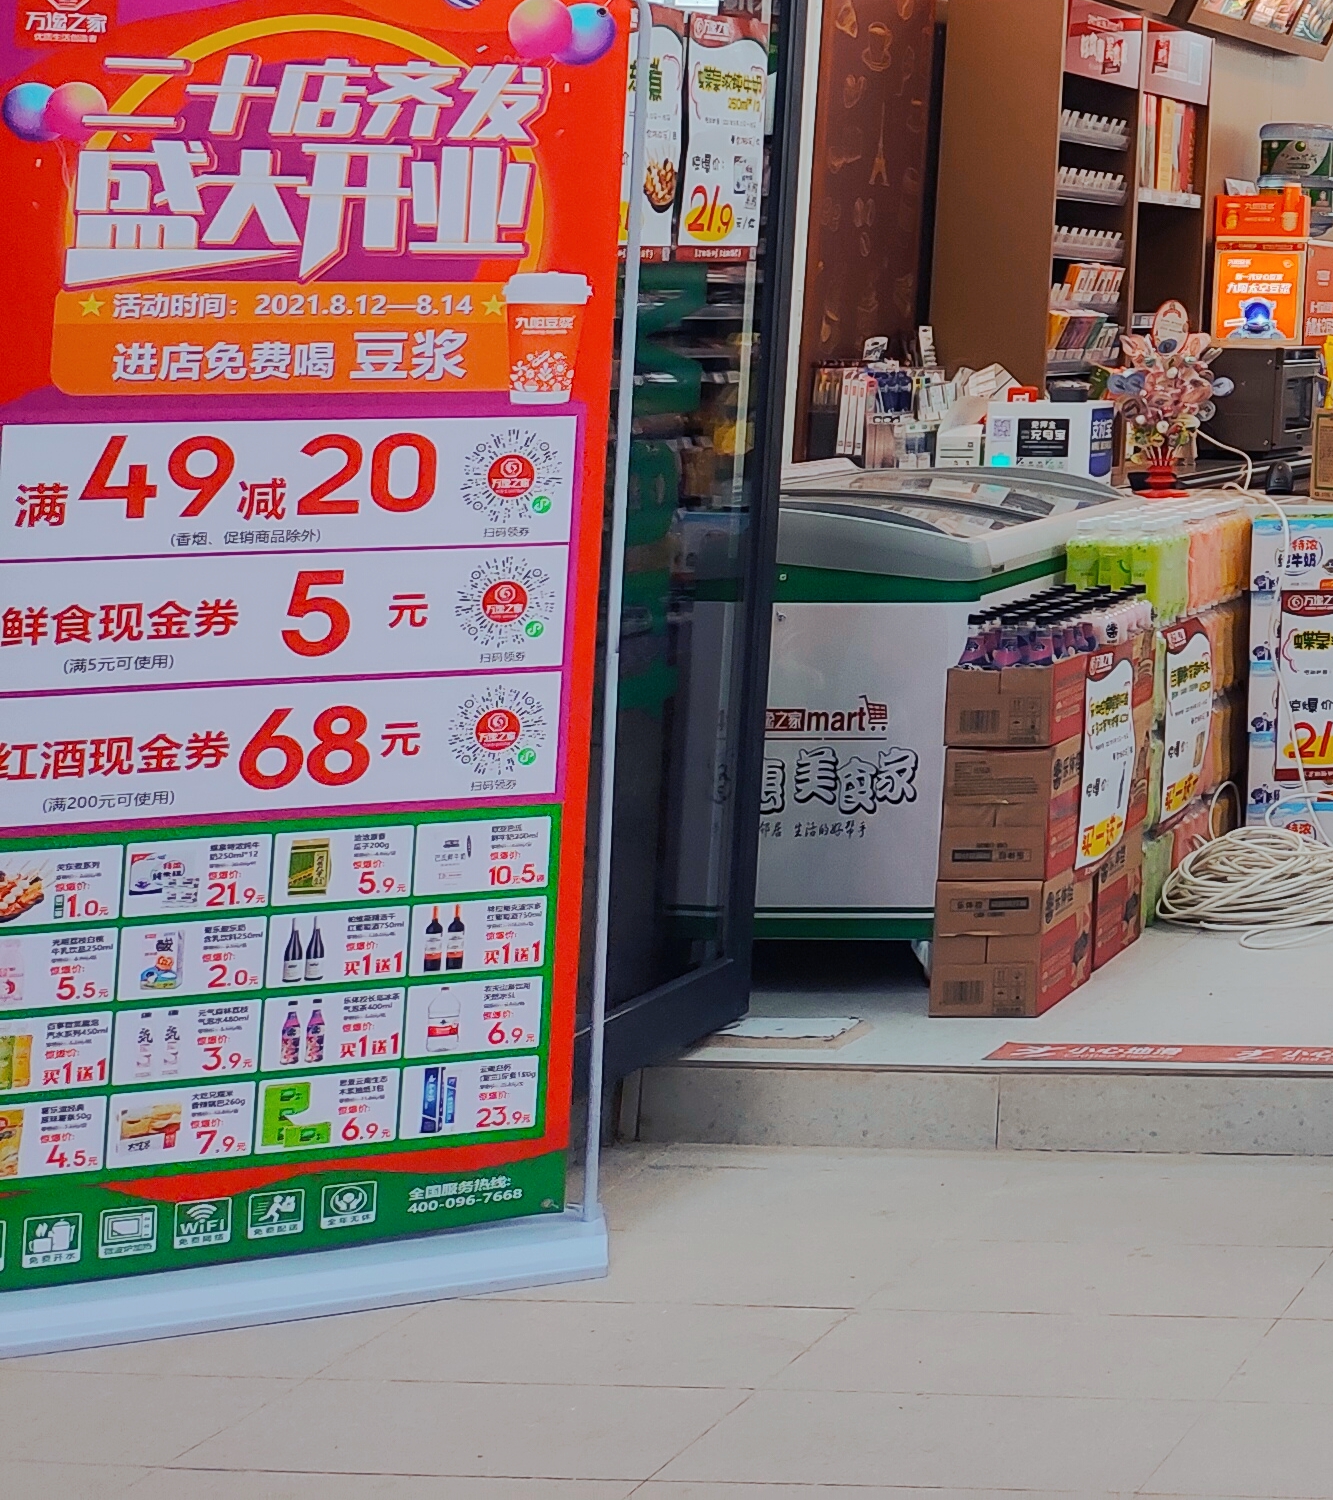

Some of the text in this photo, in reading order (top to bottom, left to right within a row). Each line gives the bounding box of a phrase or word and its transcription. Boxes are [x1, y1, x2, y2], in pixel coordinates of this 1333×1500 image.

[25, 12, 107, 33] 万逸之家
[83, 55, 548, 142] 二十店齐发
[687, 184, 733, 233] 21.9
[113, 331, 467, 381] 进店免费喝 豆浆
[484, 526, 530, 538] 扫码领券
[1291, 540, 1317, 550] 特浓
[0, 569, 428, 658] 鲜食现金券 5 元
[64, 655, 174, 674] (满5元可使用)
[480, 651, 526, 664] 扫码领券
[807, 707, 865, 731] mart
[471, 779, 517, 791] 扫码领券
[42, 790, 175, 812] (满200元可使用)
[794, 821, 867, 837] 生活的好帮手
[407, 1189, 522, 1214] 400-096-7668
